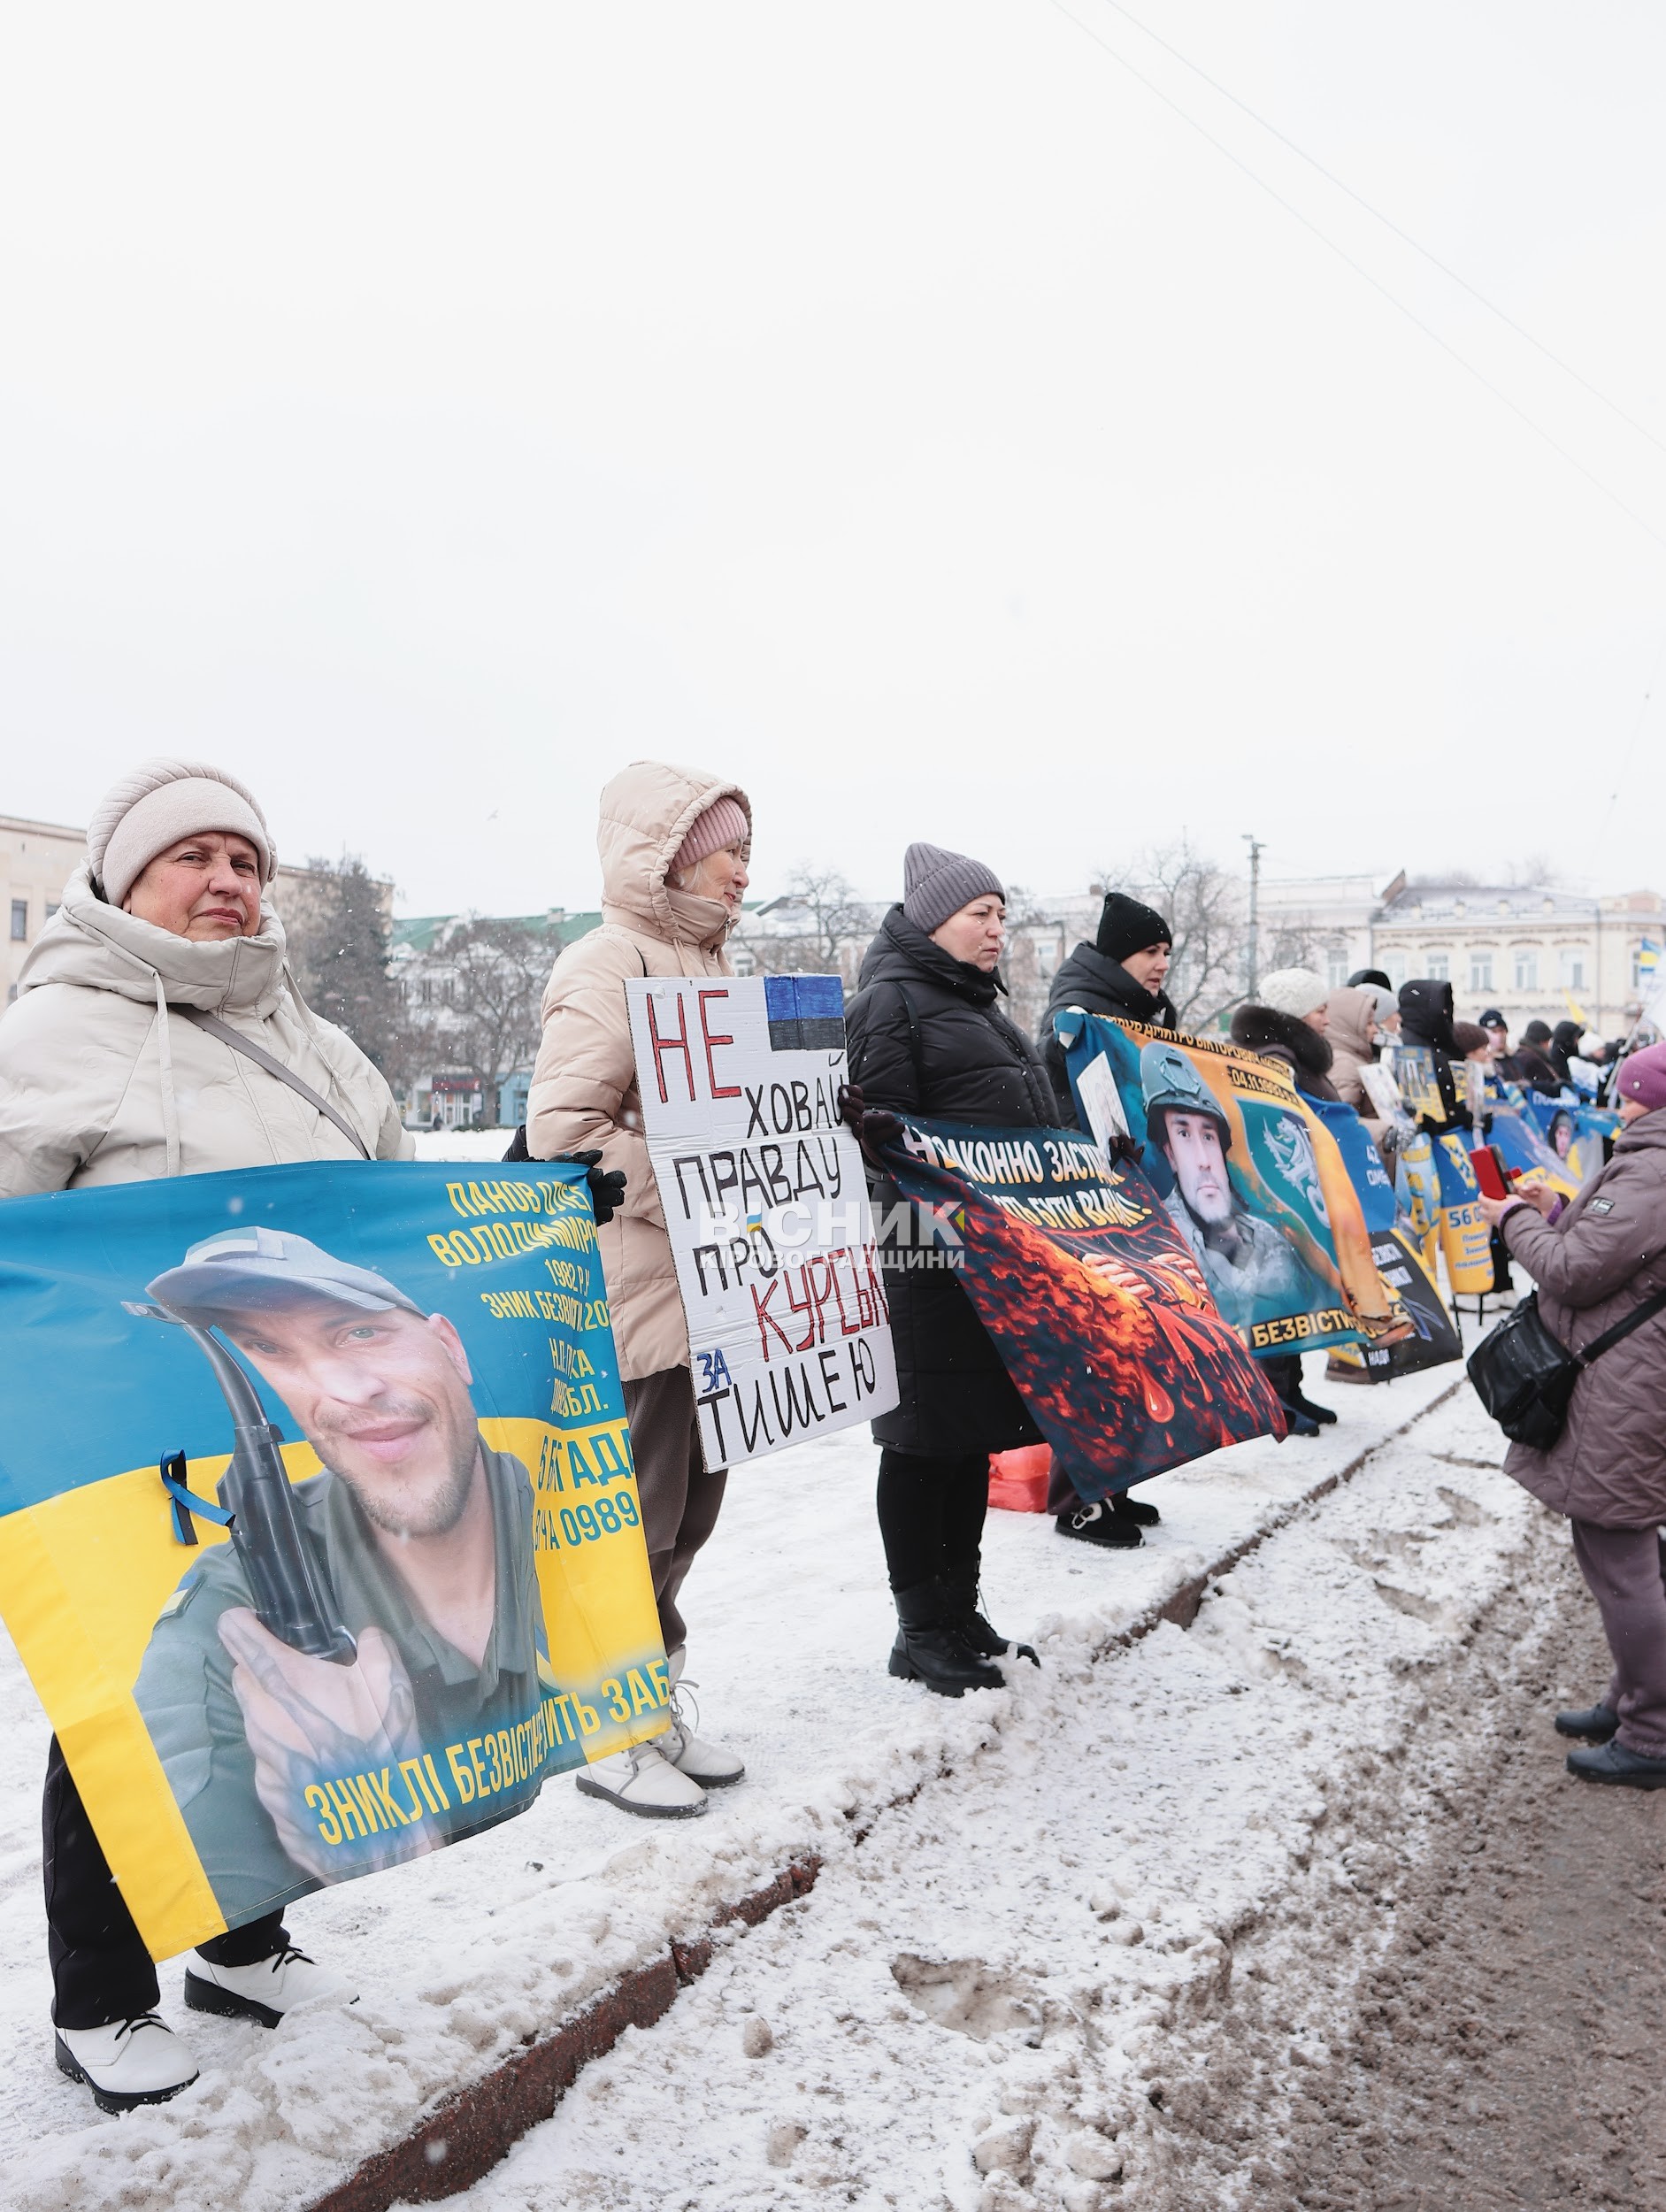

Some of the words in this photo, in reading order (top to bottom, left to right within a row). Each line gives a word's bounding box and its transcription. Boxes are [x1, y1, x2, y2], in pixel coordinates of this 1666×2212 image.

[647, 989, 742, 1103] НЕ
[744, 1051, 845, 1139] ХОВАЙ
[445, 1180, 541, 1218] ПАНОВ
[672, 1136, 841, 1219] ПРАВДУ
[544, 1258, 578, 1293] 1982
[692, 1226, 775, 1296] ПРО
[480, 1290, 541, 1319] ЗНИК
[696, 1348, 733, 1394] ЗА
[697, 1337, 876, 1463] ТИШЕЮ
[304, 1754, 451, 1846] ЗНИКЛІ
[601, 1657, 670, 1724] ЗАБ
